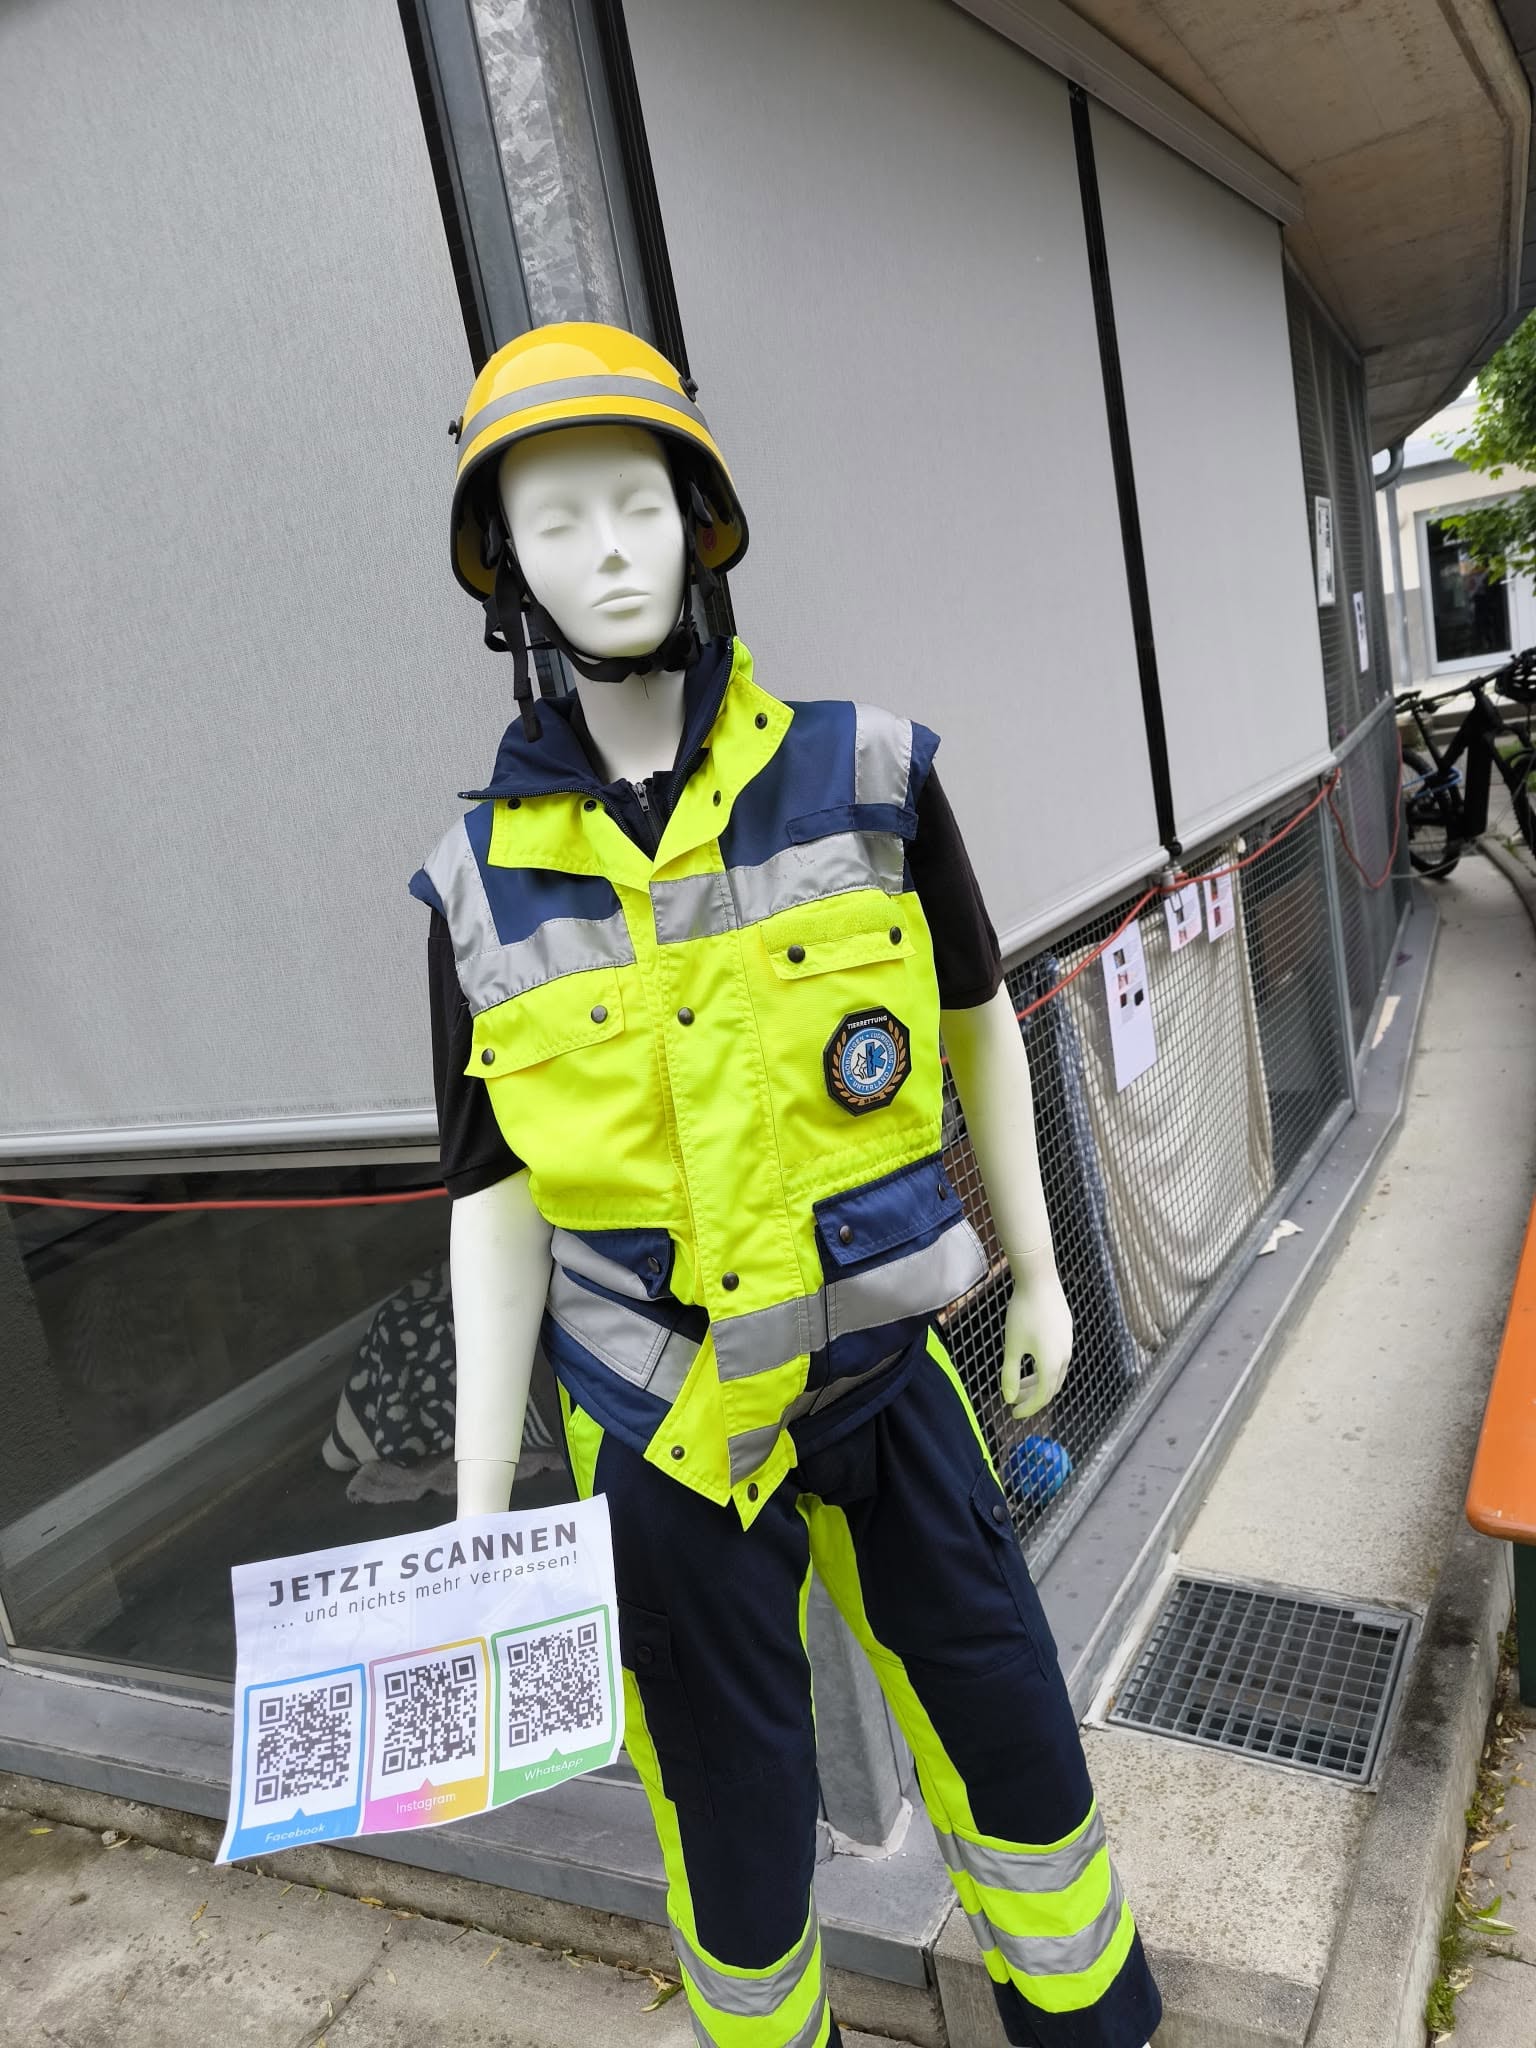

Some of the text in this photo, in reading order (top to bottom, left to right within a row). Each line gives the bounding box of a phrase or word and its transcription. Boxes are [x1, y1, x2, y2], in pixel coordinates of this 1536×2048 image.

[847, 1015, 888, 1030] TIERRETTUNG
[852, 1072, 890, 1091] UNTERLAND
[268, 1521, 577, 1608] JETZT SCANNEN
[304, 1602, 338, 1624] und
[348, 1590, 406, 1614] nichts
[415, 1576, 461, 1600] mehr
[470, 1550, 578, 1586] verpassen!
[524, 1758, 583, 1781] WhatsApp
[396, 1793, 456, 1815] Instagram
[265, 1823, 326, 1843] Facebook
